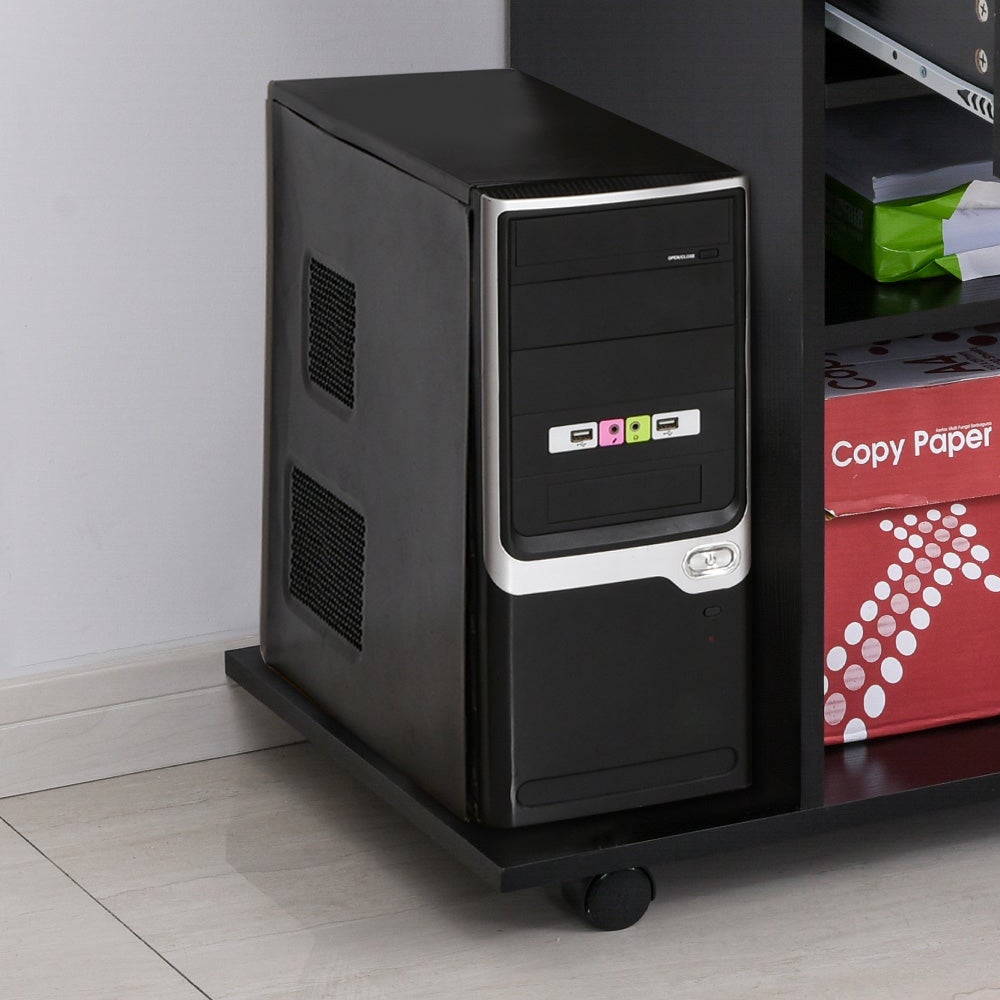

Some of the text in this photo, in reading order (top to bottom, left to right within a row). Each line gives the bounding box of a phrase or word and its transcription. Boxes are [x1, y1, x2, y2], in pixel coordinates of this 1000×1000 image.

[904, 354, 984, 374] A4
[831, 427, 992, 468] Copy Paper
